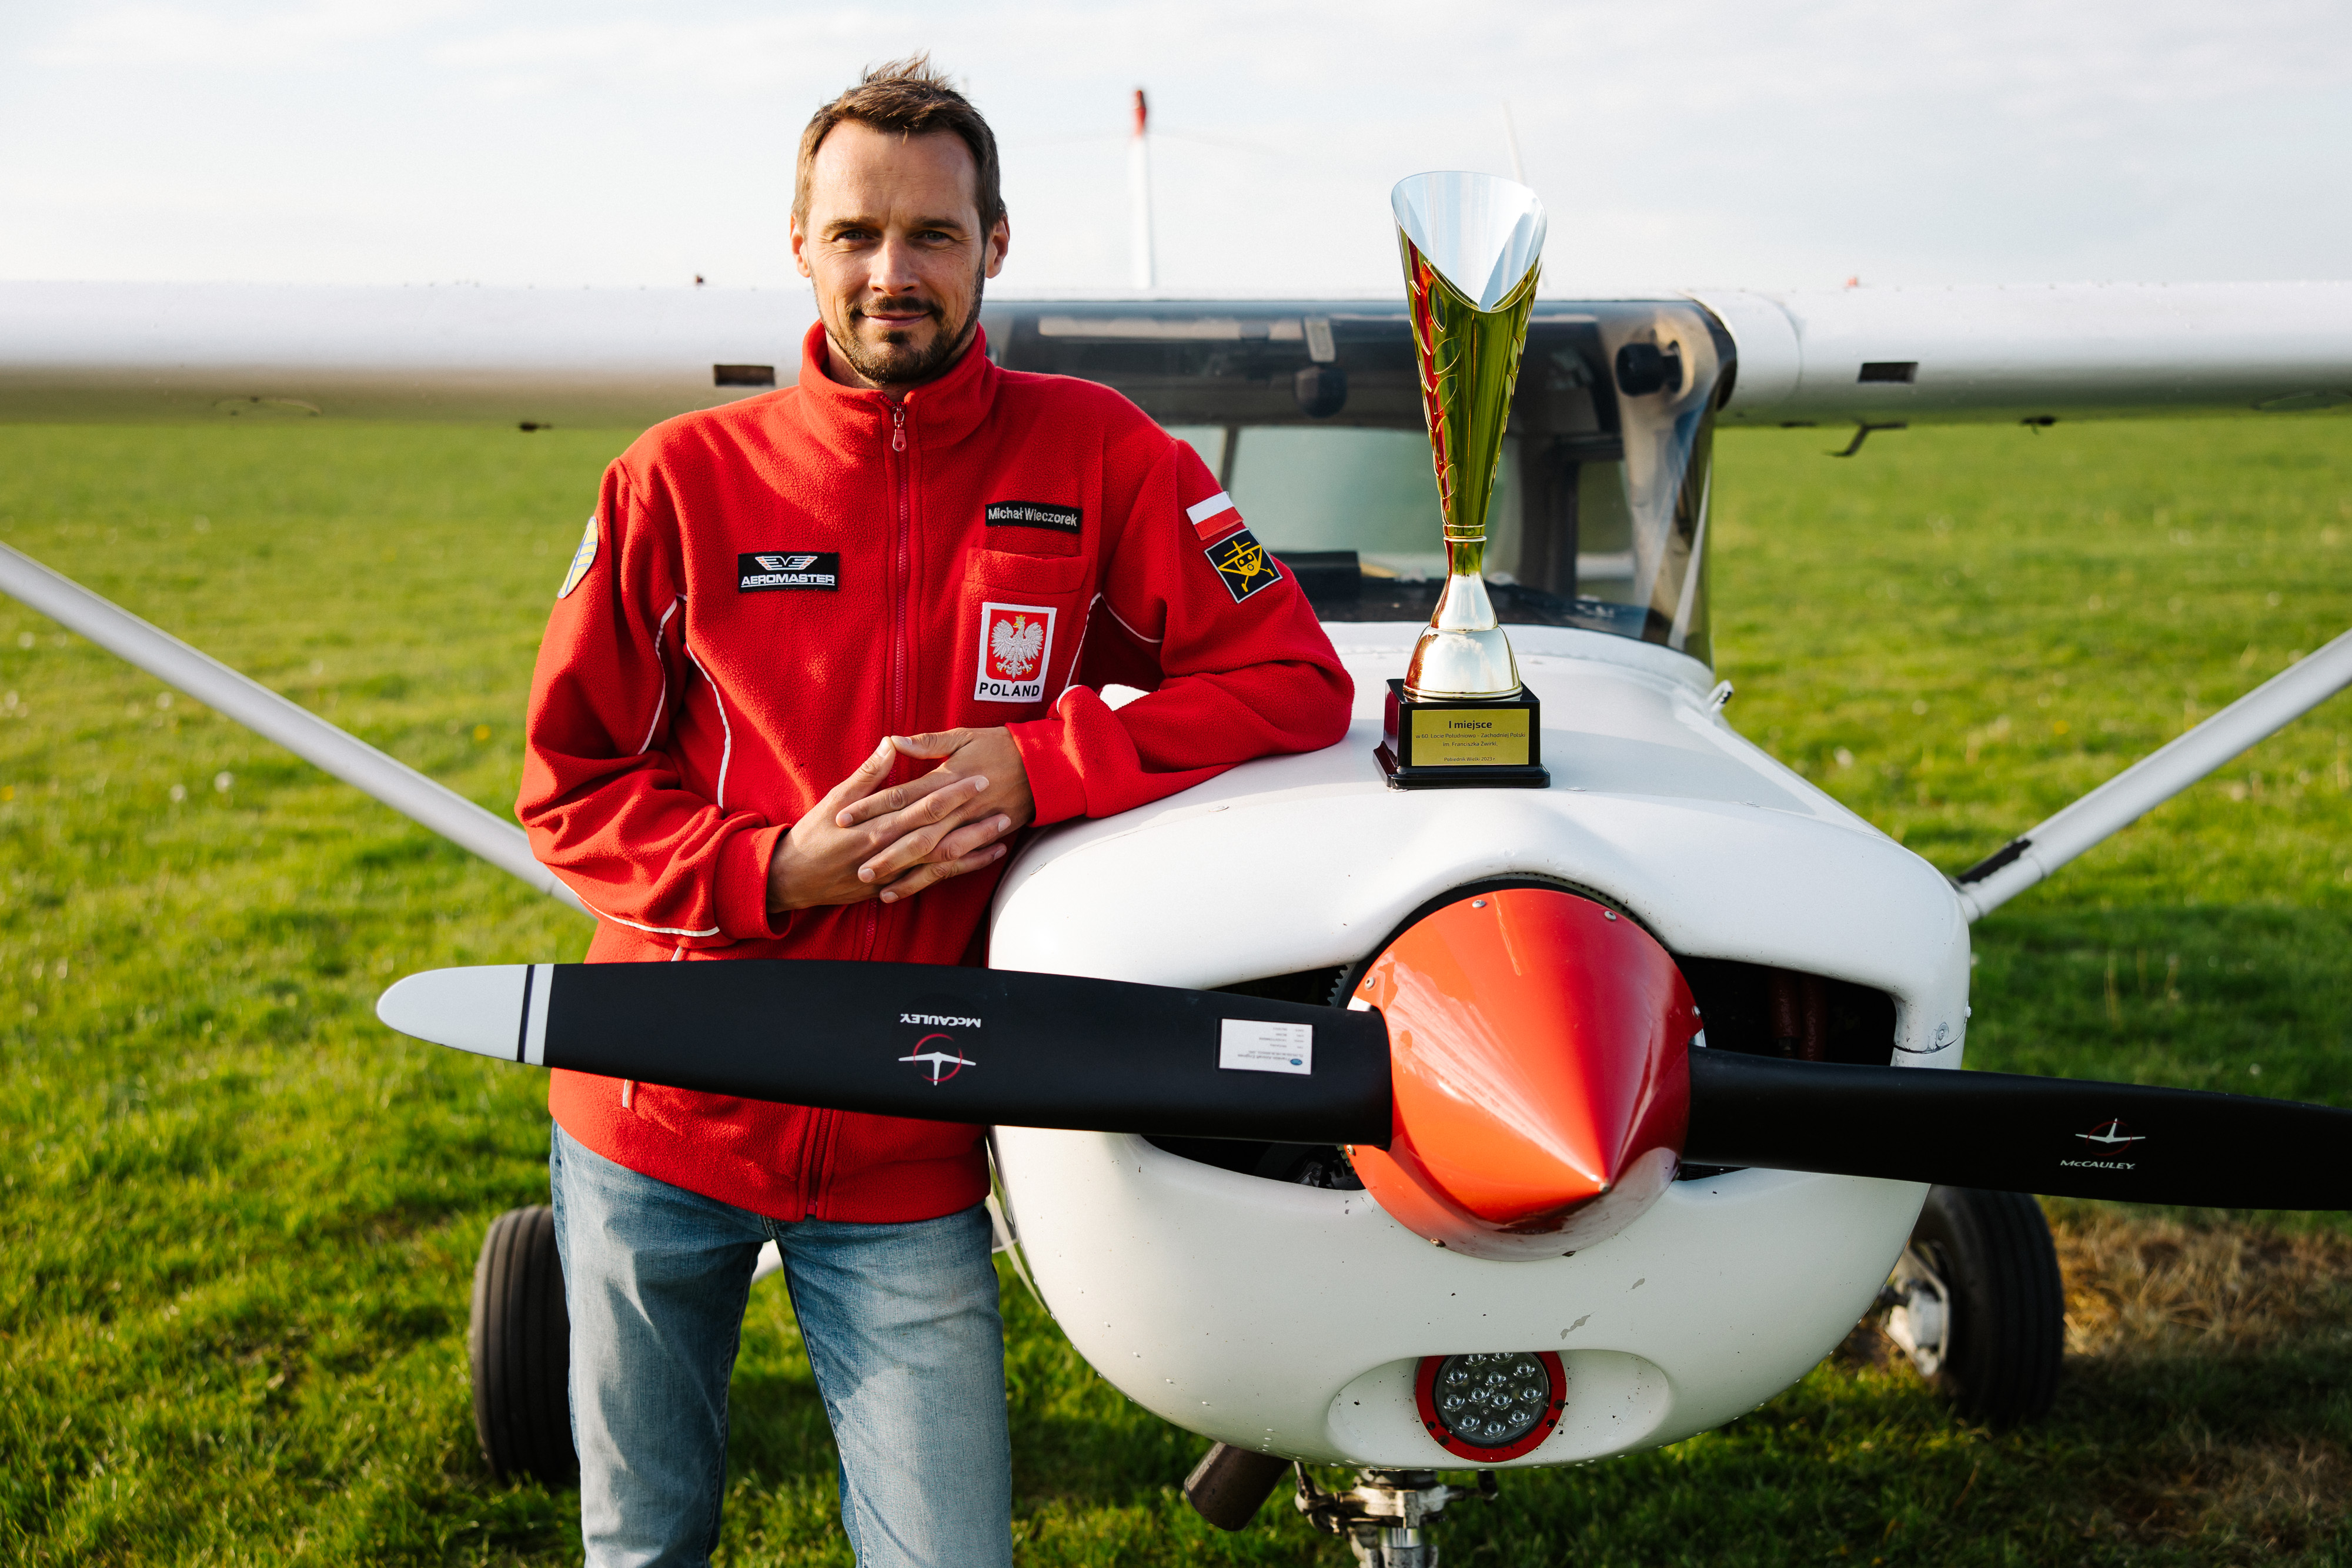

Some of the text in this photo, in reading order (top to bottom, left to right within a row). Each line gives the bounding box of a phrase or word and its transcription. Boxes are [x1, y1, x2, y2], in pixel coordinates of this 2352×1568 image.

[988, 507, 1078, 527] Michał Wieczorek
[741, 573, 835, 586] AEROMASTER
[978, 682, 1040, 697] POLAND
[1454, 720, 1492, 730] miejsce
